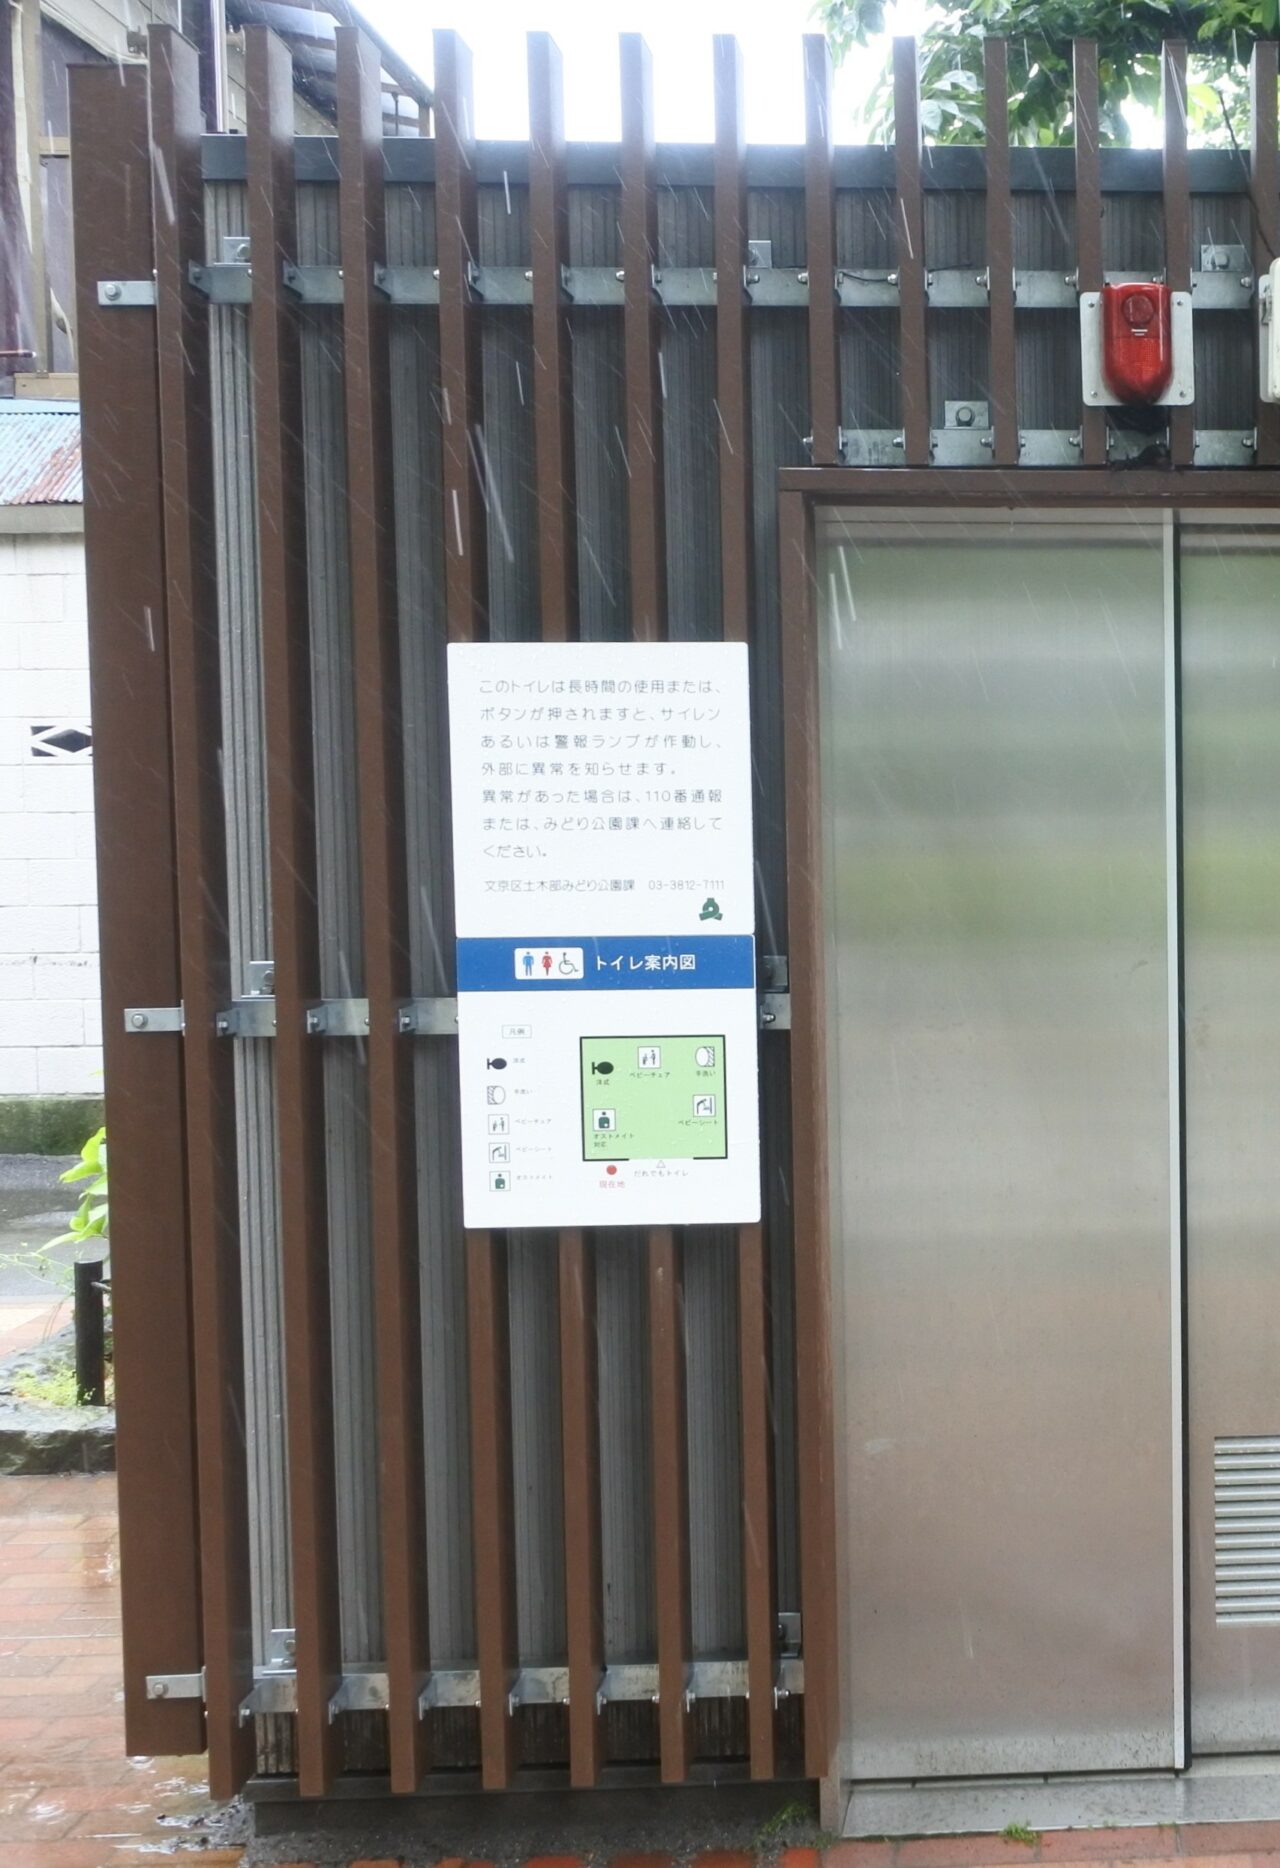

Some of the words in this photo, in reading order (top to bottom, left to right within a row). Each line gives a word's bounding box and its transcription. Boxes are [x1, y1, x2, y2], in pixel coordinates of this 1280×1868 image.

[480, 679, 721, 694] このトイレは長時間の使用または、
[480, 707, 721, 721] ボタンが押されますと、サイレン
[481, 734, 722, 749] あるいは警報ランプが作動し、
[482, 762, 676, 776] 外部に異常を知らせます。
[482, 789, 722, 804] 異常があった場合は、110番通報
[483, 816, 723, 831] または、みどり公園課へ連絡して
[483, 844, 547, 858] ください。
[485, 880, 635, 892] 文京区土木部みどり公園課
[648, 880, 725, 891] 03-3812-7111
[595, 954, 696, 971] トイレ案内図
[599, 1180, 626, 1189] 現在地
